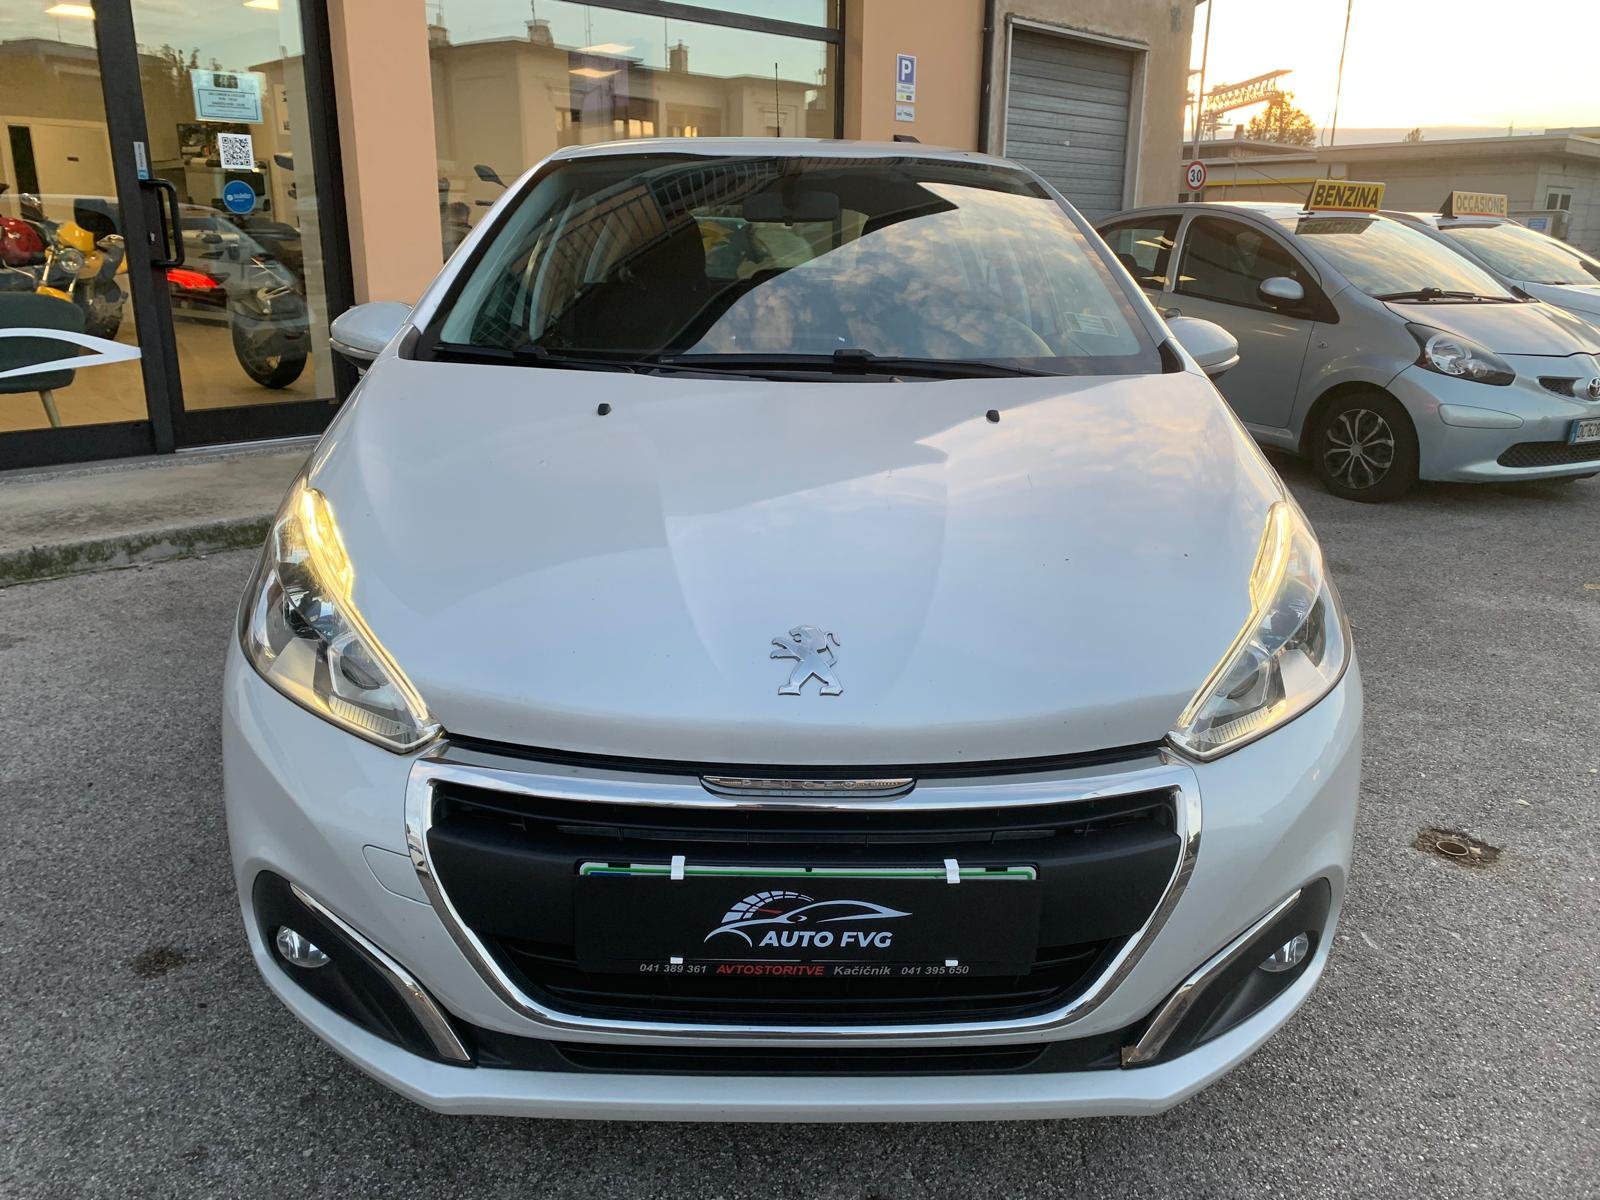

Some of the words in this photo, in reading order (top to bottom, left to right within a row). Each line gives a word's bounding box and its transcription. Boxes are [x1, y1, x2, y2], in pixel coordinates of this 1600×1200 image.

[901, 59, 912, 81] P
[1190, 169, 1202, 183] 30
[1313, 185, 1379, 208] BENZINA
[1456, 195, 1505, 214] OCCASIONE
[759, 930, 834, 948] AUTO
[840, 931, 893, 948] FVG
[639, 963, 660, 973] 041
[663, 963, 684, 974] 389
[686, 965, 707, 974] 361
[716, 965, 825, 976] AVTOSTORITVE
[901, 966, 922, 976] 041
[924, 966, 946, 975] 395
[948, 965, 970, 975] 650
